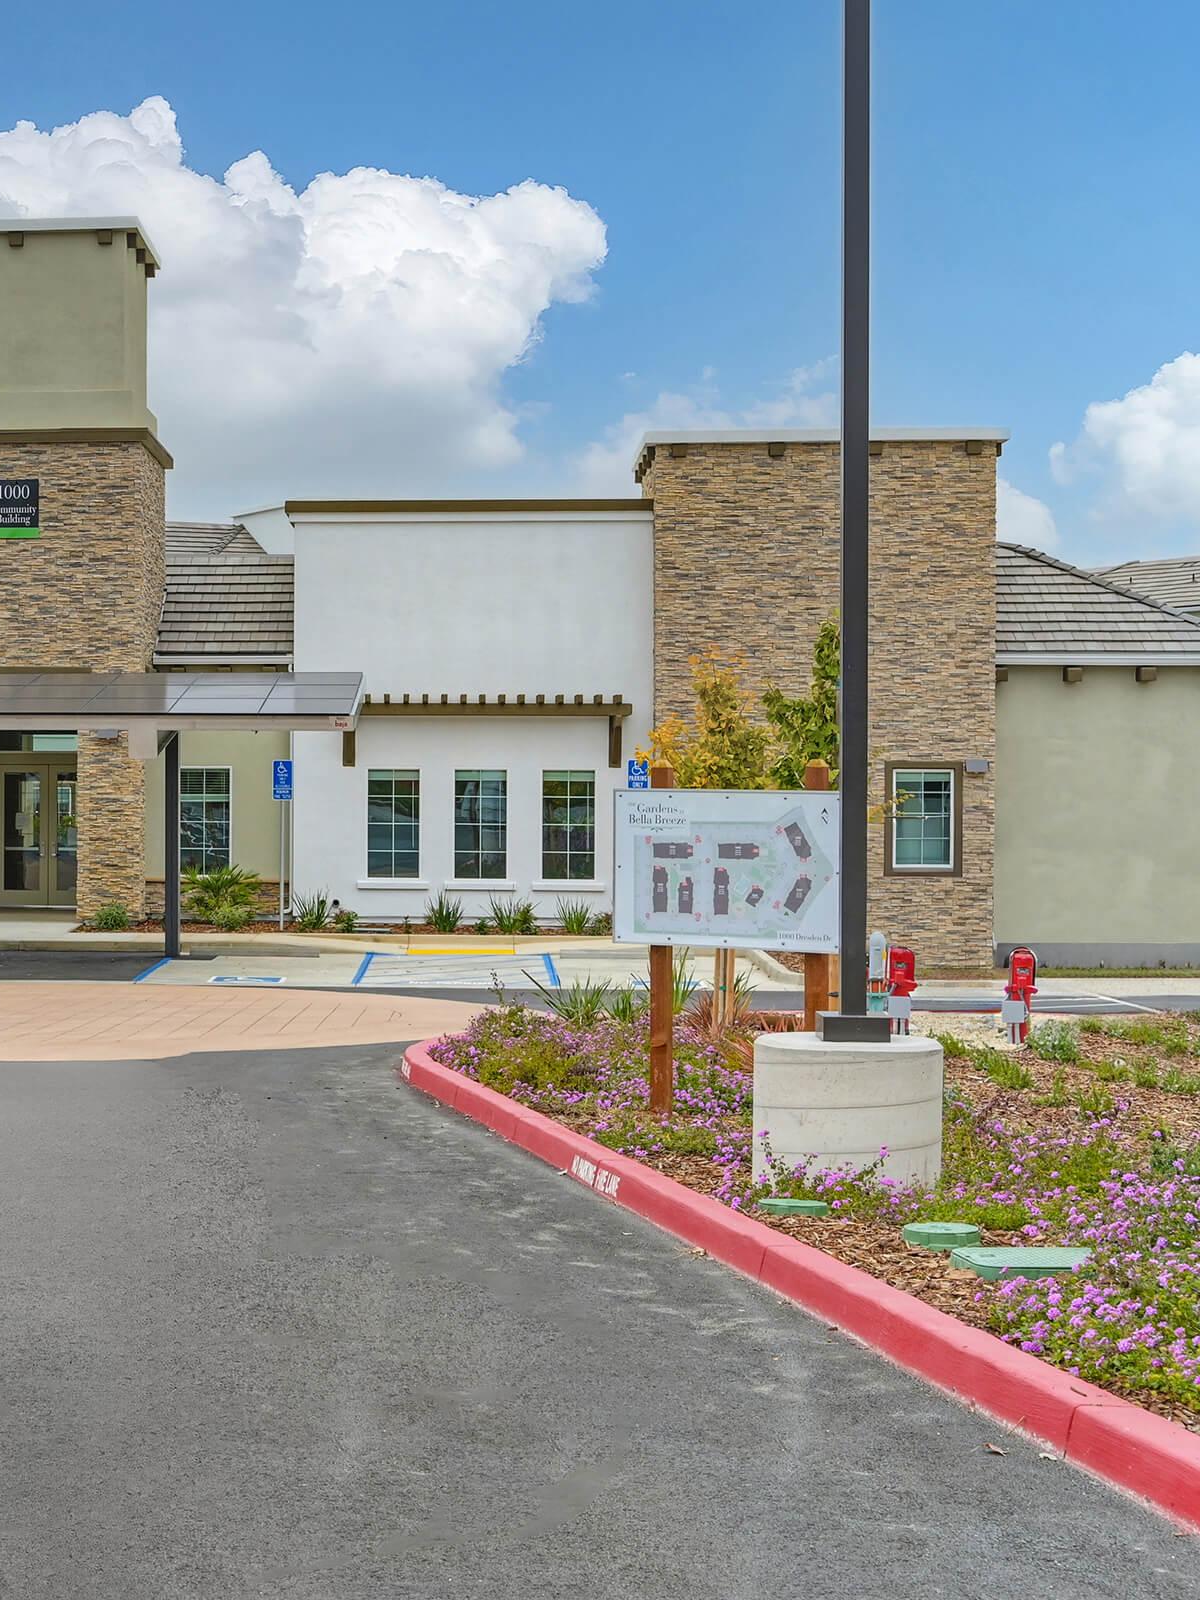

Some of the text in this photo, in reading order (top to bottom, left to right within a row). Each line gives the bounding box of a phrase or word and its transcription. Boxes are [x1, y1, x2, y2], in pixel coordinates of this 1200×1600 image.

[636, 803, 678, 814] Gardens
[629, 814, 687, 825] Bella Breeze
[779, 932, 795, 940] 1000
[796, 933, 822, 941] Dresden
[577, 1158, 597, 1186] PARKING
[595, 1168, 609, 1192] FIRE
[605, 1174, 621, 1197] LANE
